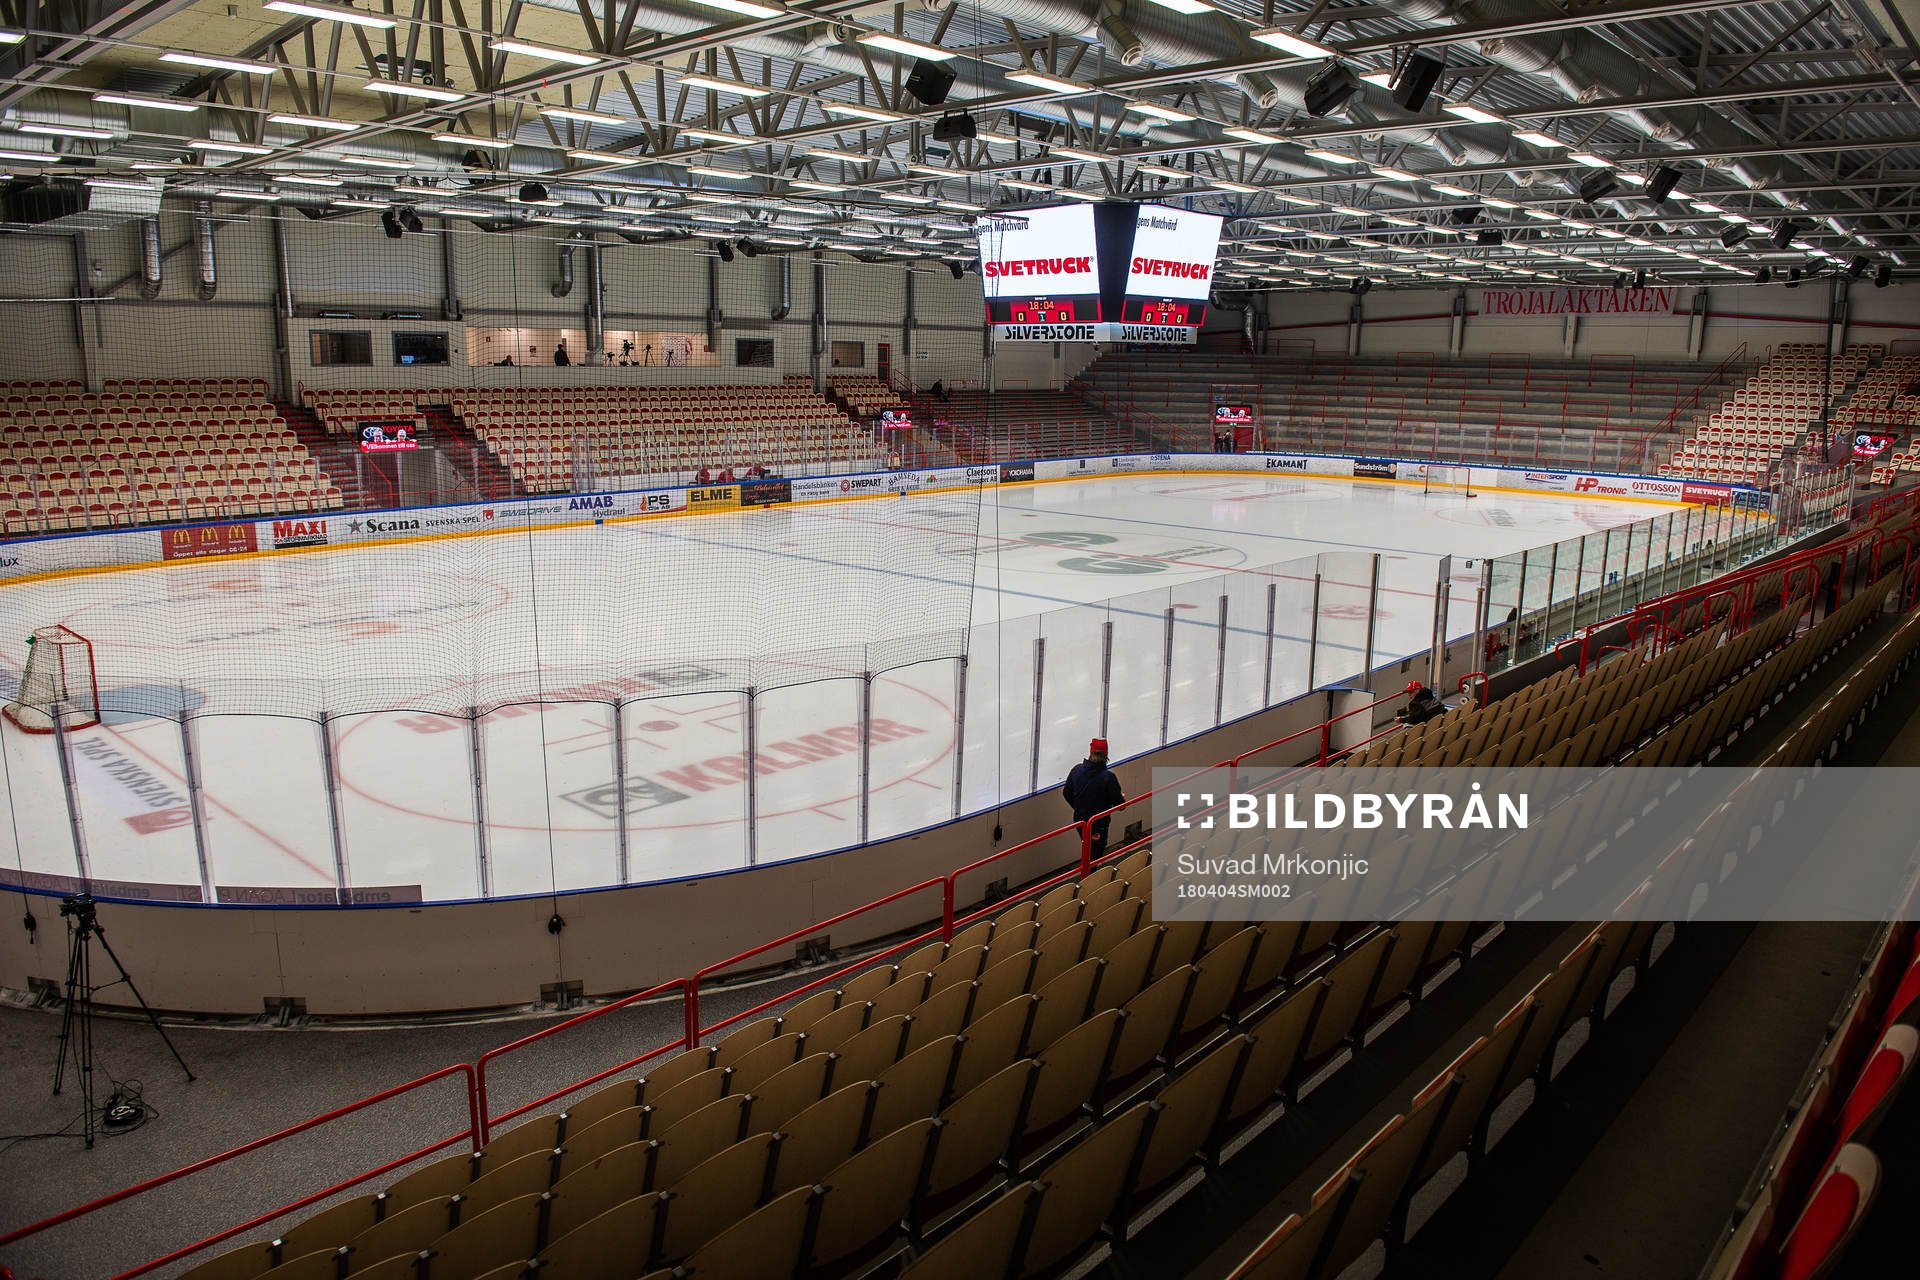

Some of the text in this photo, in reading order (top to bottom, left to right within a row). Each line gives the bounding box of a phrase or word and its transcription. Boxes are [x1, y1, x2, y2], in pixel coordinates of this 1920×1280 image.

[984, 256, 1091, 278] SVETRUCK
[1131, 257, 1209, 280] SVETRUCK
[1028, 301, 1055, 310] 18:04
[1156, 302, 1176, 312] 18:04
[1018, 311, 1067, 322] 0 1 0
[1145, 312, 1152, 322] 0
[1176, 314, 1183, 324] 0
[1266, 458, 1308, 470] EKAMANT
[1354, 462, 1388, 472] Sundström
[966, 466, 998, 477] Claessons
[1009, 468, 1034, 477] YOKOHAMA
[1530, 472, 1568, 481] INTERSPORT
[792, 481, 838, 491] Handelsbanken
[851, 478, 882, 489] SWEPART
[1574, 477, 1599, 492] HP
[1597, 486, 1627, 495] TRONIC
[1631, 481, 1681, 493] OTTOSSON
[690, 488, 733, 502] ELME
[1685, 486, 1730, 497] SVETRUCK
[568, 495, 614, 511] AMAB
[647, 494, 670, 506] PS
[592, 507, 626, 518] Hydraul
[366, 518, 420, 534] Scana
[425, 516, 481, 527] SVENSKA SPEL
[272, 520, 327, 539] MAXI
[656, 718, 928, 792] KALMAR
